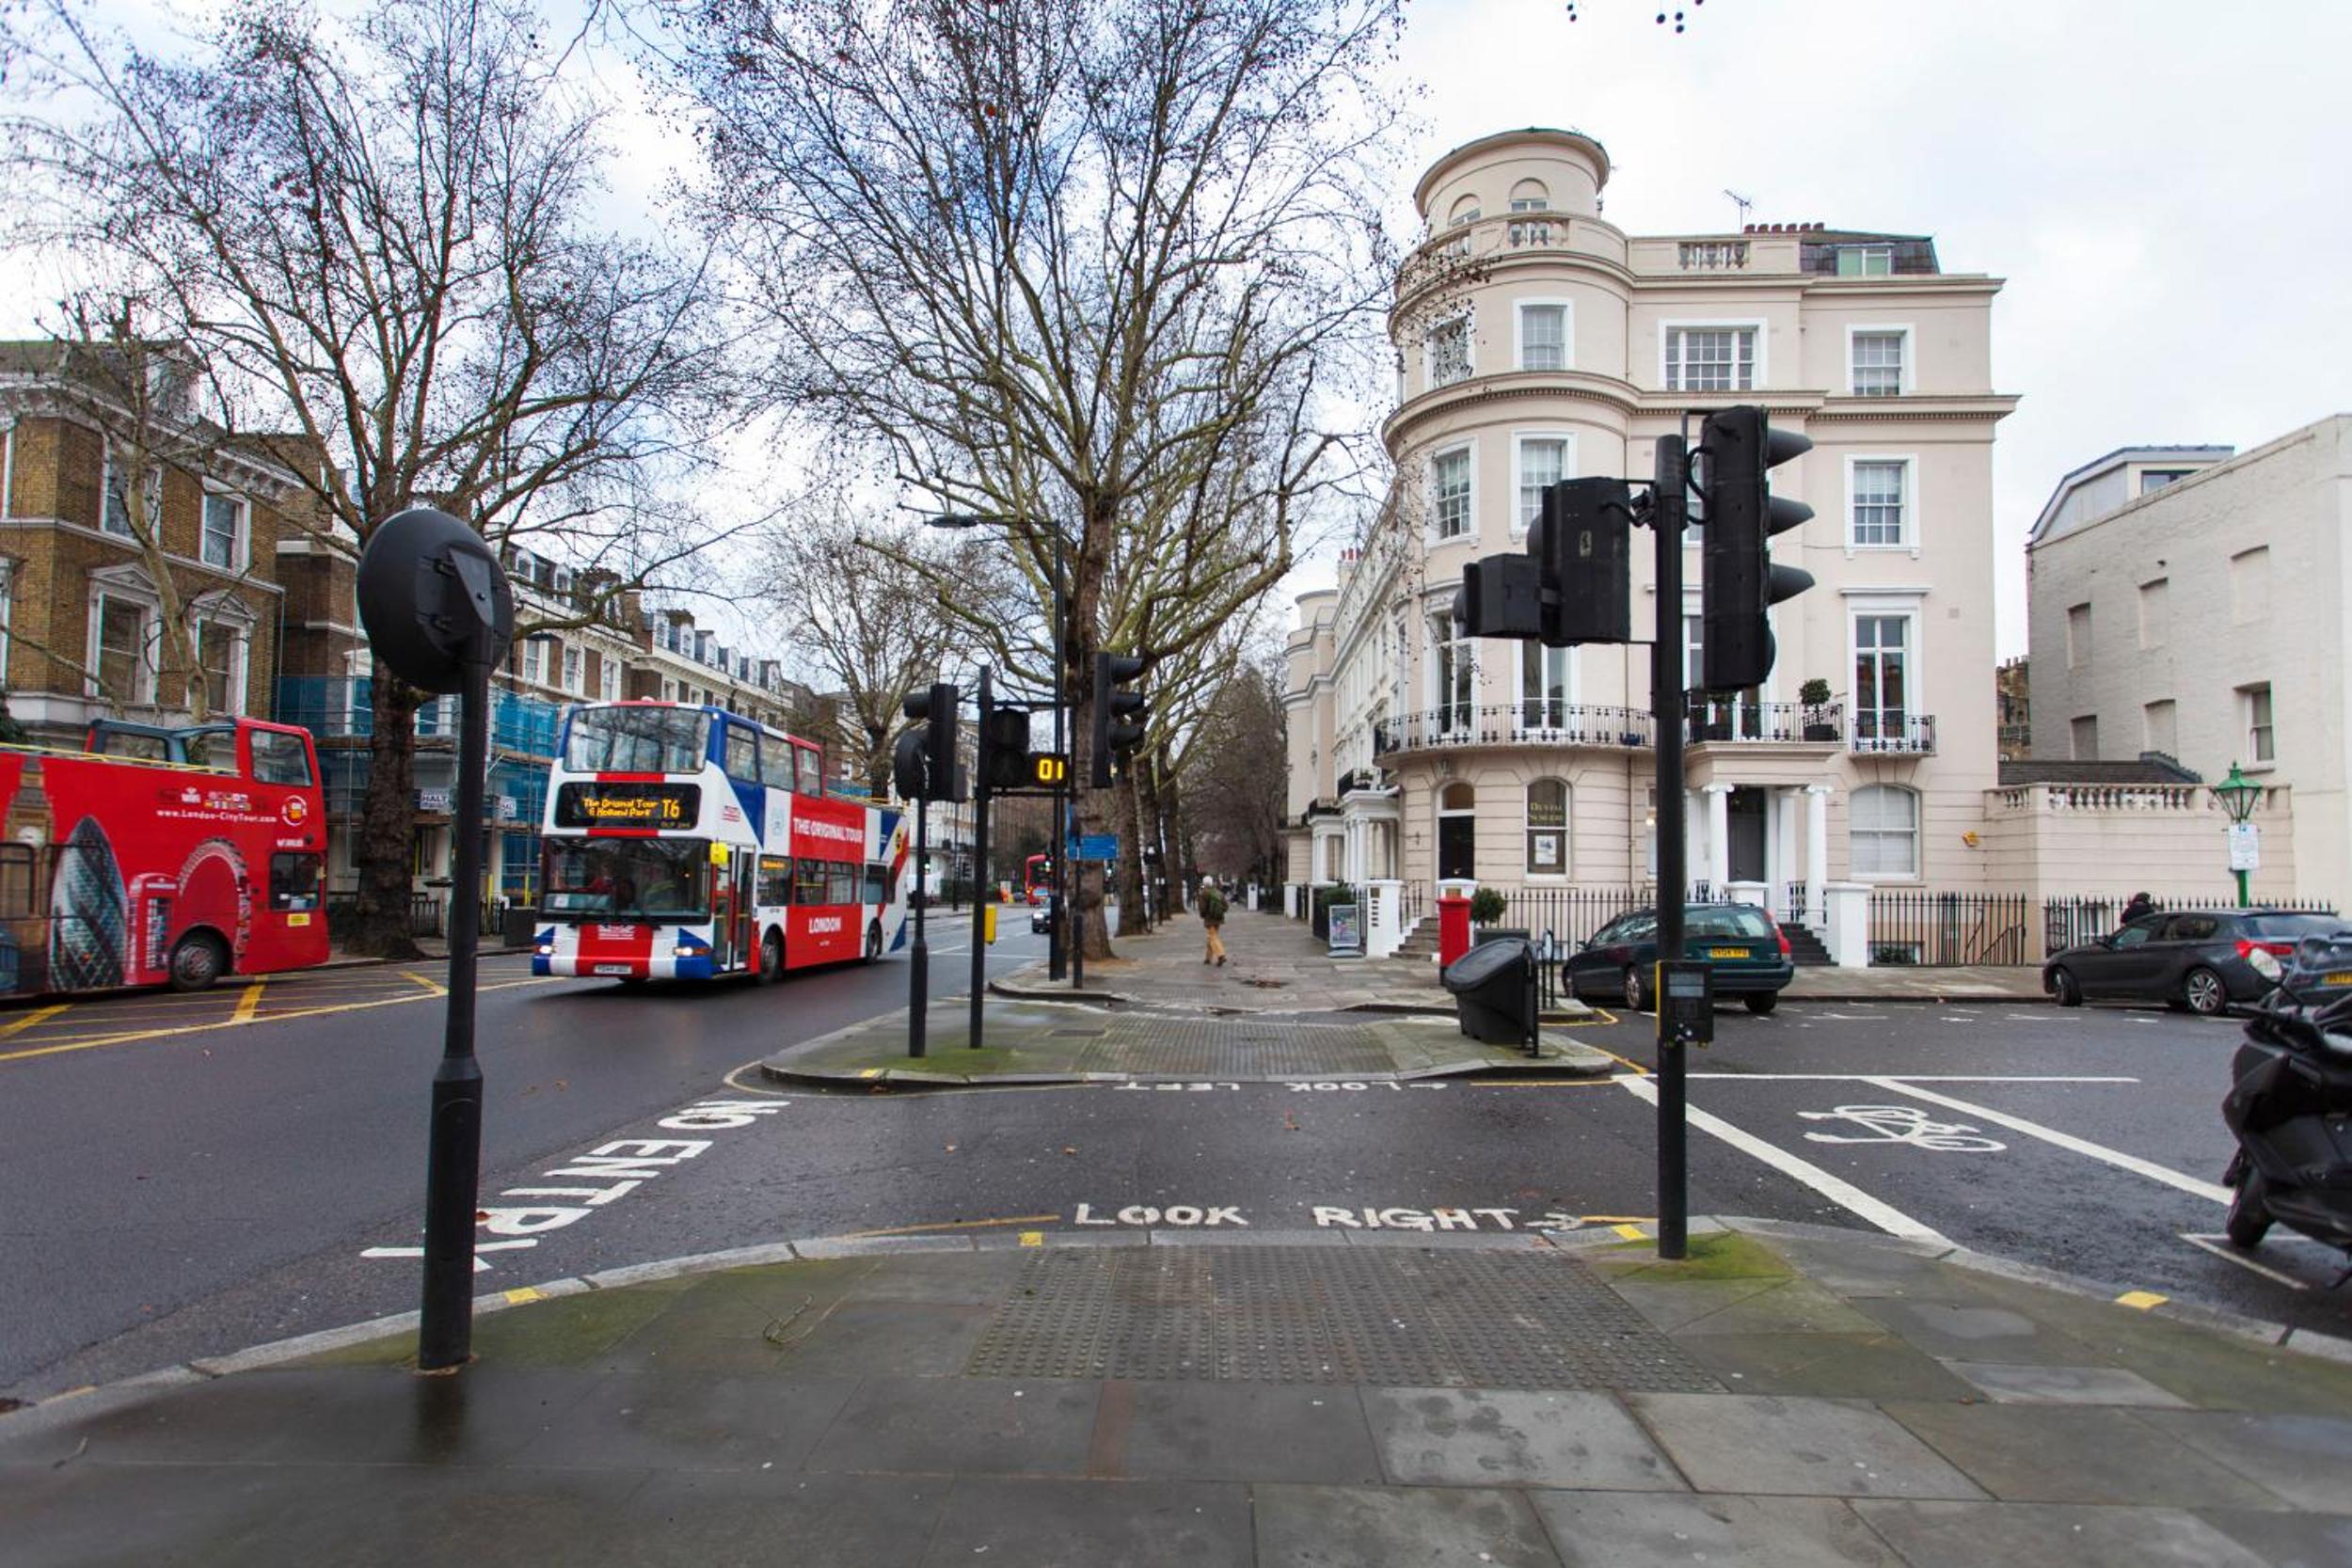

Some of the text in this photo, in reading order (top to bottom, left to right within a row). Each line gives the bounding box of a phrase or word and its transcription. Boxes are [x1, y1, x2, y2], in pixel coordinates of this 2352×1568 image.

[1038, 758, 1063, 780] 01
[583, 798, 658, 808] The Original Tour
[596, 807, 628, 816] Holland
[629, 808, 651, 817] Park
[662, 799, 680, 817] T6
[793, 817, 809, 834] THE
[810, 820, 844, 841] ORIGINAL
[845, 827, 864, 844] TOUR
[809, 916, 841, 934] LONDON
[1114, 1081, 1403, 1092] LOOK LEFT
[359, 1101, 791, 1273] NO ENTRY
[1073, 1203, 1521, 1232] LOOK RIGHT
